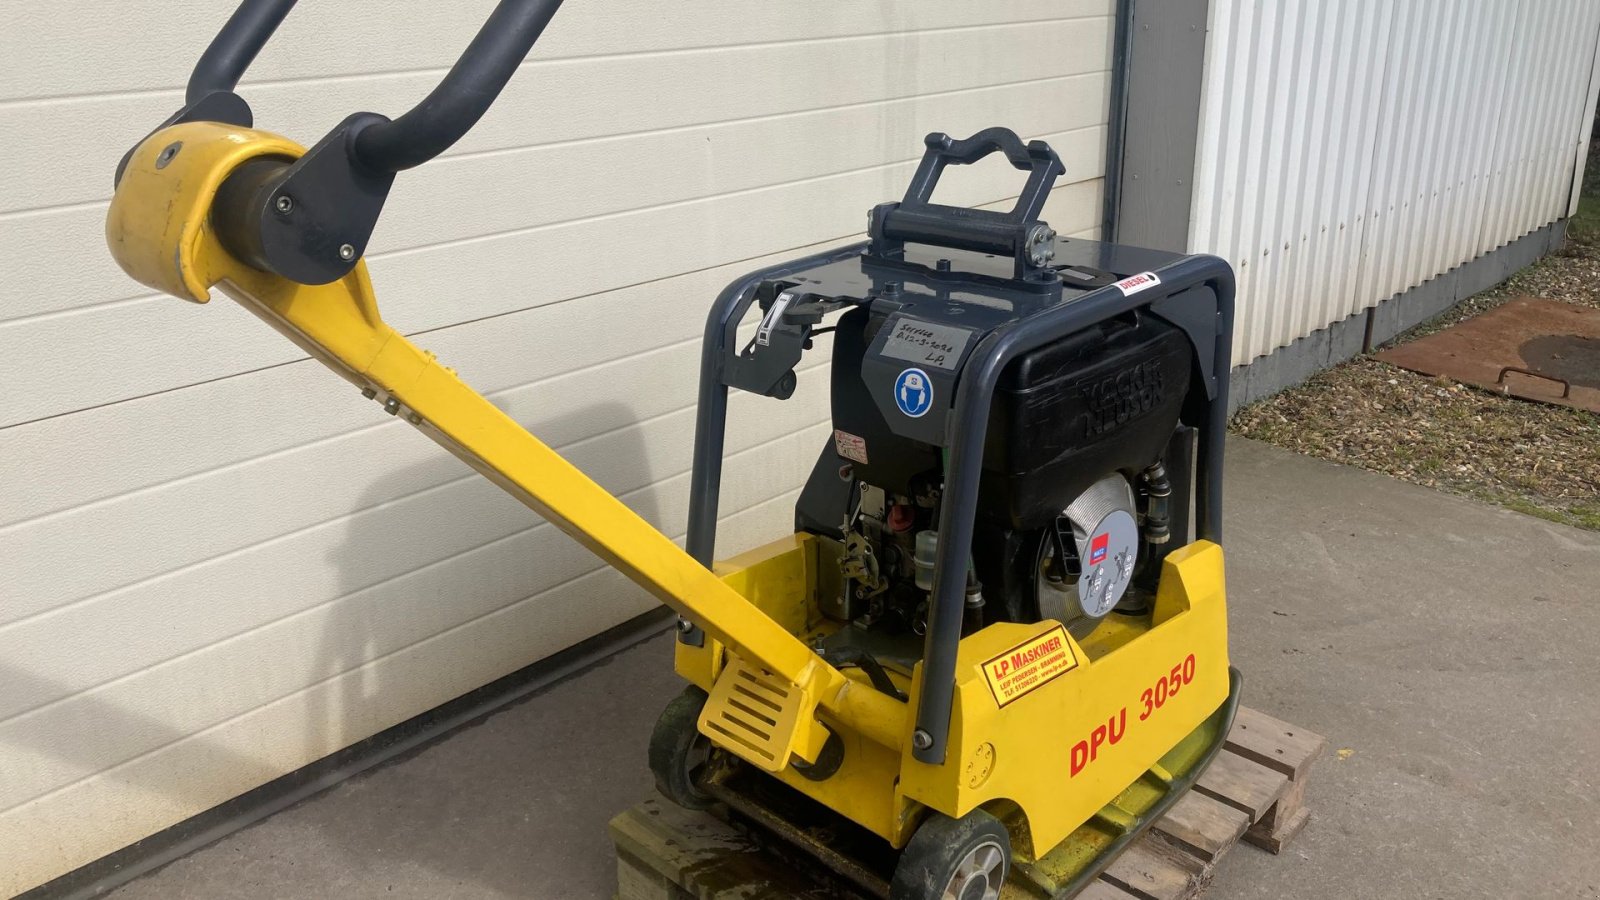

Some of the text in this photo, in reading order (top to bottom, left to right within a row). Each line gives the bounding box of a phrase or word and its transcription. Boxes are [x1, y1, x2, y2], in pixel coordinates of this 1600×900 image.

[1119, 275, 1150, 290] DIESEL
[900, 323, 933, 338] Service
[993, 659, 1009, 680] LP
[999, 679, 1011, 691] LEIF
[1012, 665, 1038, 685] PEDERSEN
[1040, 651, 1066, 669] BRAMMING
[1070, 653, 1196, 778] DPU 3050
